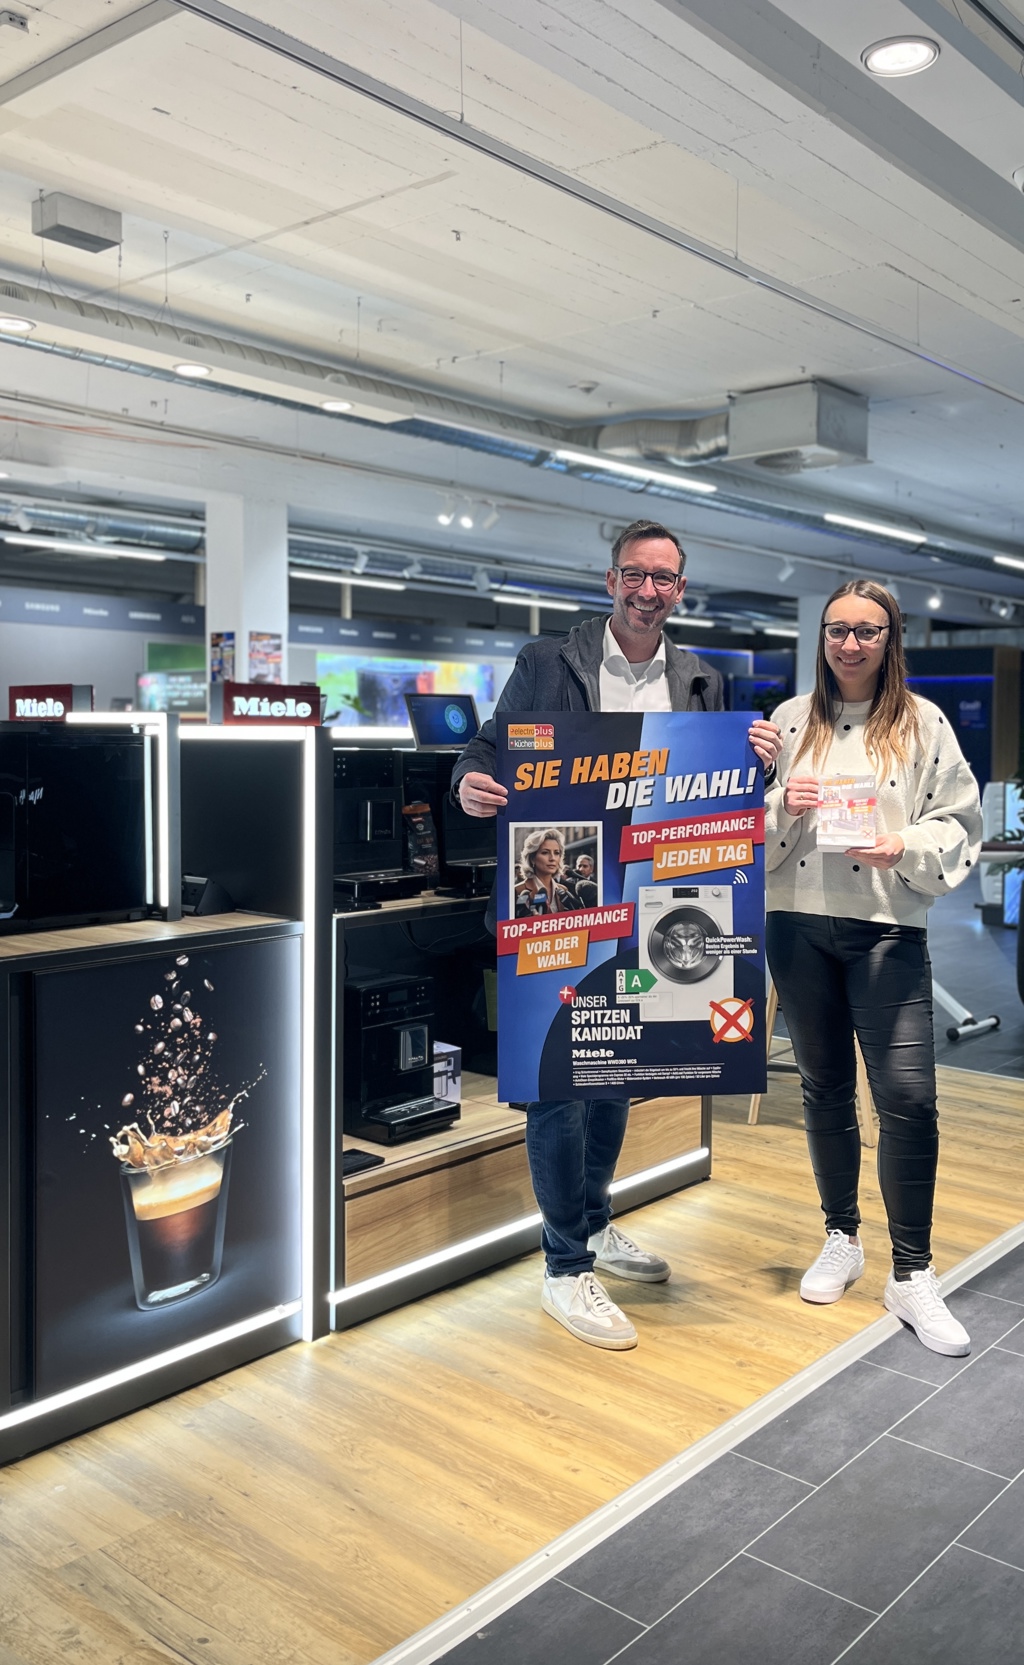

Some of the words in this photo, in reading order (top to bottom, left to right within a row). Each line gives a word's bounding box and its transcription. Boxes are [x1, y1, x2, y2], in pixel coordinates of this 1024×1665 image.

[15, 698, 64, 717] Miele
[233, 696, 312, 717] Miele
[514, 760, 562, 791] SIE
[570, 748, 669, 784] HABEN
[605, 779, 655, 810] DIE
[664, 767, 757, 803] WAHL!
[631, 816, 755, 845] TOP-PERFORMANCE
[656, 847, 713, 869] JEDEN
[716, 844, 748, 863] TAG
[502, 908, 628, 939] TOP-PERFORMANCE
[526, 938, 551, 955] VOR
[554, 935, 579, 951] DER
[537, 951, 572, 968] WAHL
[631, 974, 642, 988] A
[571, 996, 607, 1008] UNSER
[571, 1009, 630, 1025] SPITZEN
[571, 1026, 643, 1042] KANDIDAT
[572, 1049, 615, 1058] Miele
